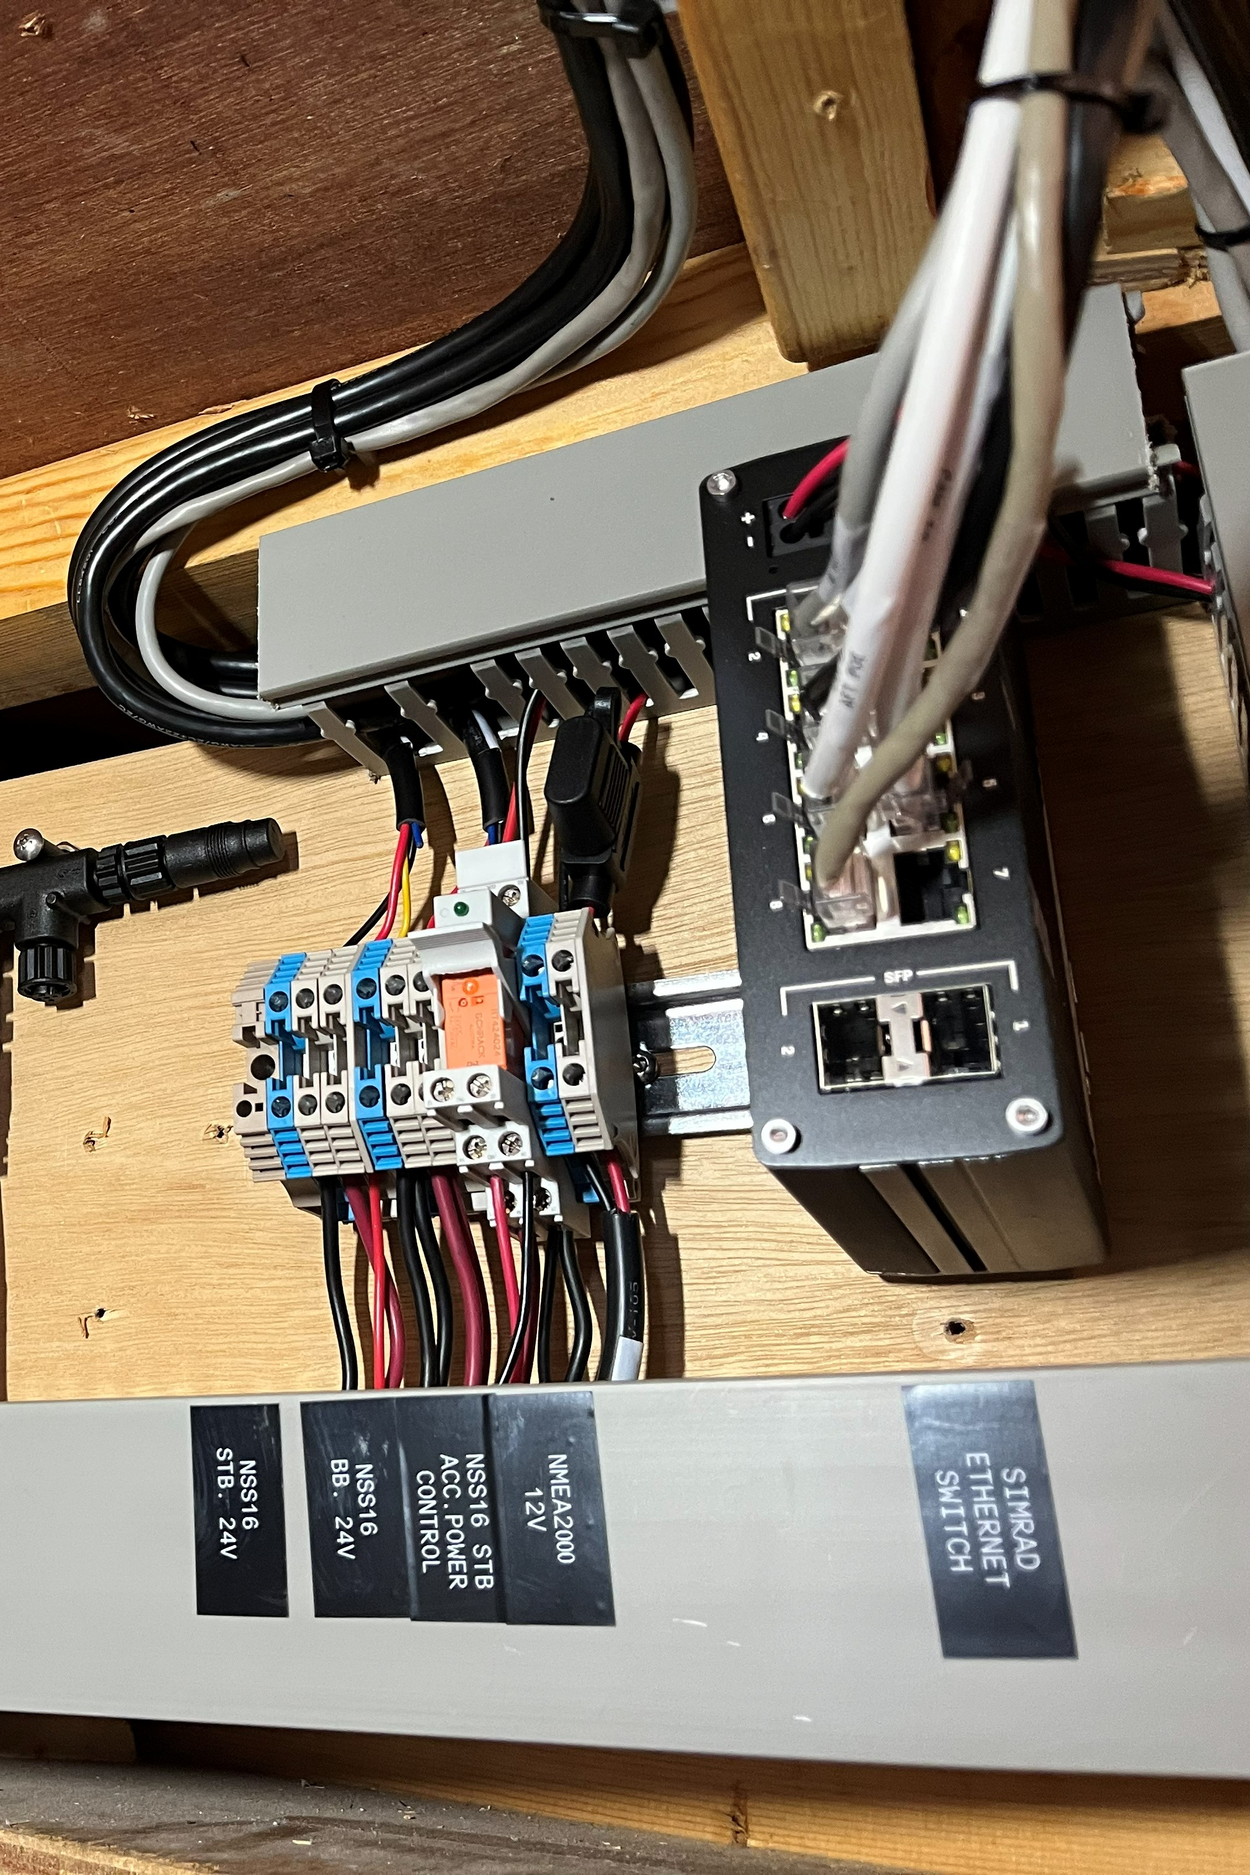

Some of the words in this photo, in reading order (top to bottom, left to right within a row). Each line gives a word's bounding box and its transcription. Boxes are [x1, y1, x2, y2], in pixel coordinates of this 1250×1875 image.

[748, 651, 761, 662] 2
[756, 731, 769, 741] 4
[993, 867, 1010, 877] 7
[884, 968, 914, 984] SFP
[1013, 1020, 1029, 1031] 1
[781, 1045, 795, 1056] 2
[216, 1447, 235, 1498] STB.
[239, 1460, 260, 1530] NSS16
[330, 1458, 351, 1498] BB.
[465, 1453, 490, 1527] NSS16
[354, 1463, 379, 1536] NSS16
[416, 1470, 441, 1574] CONTROL
[524, 1487, 548, 1532] 12V
[548, 1453, 576, 1564] NMEA2000
[935, 1469, 974, 1571] SWITCH
[966, 1452, 1010, 1589] ETHERNET
[1000, 1467, 1041, 1571] SIMRAD
[218, 1517, 238, 1560] 24V
[334, 1516, 356, 1560] 24V
[472, 1544, 494, 1589] STB
